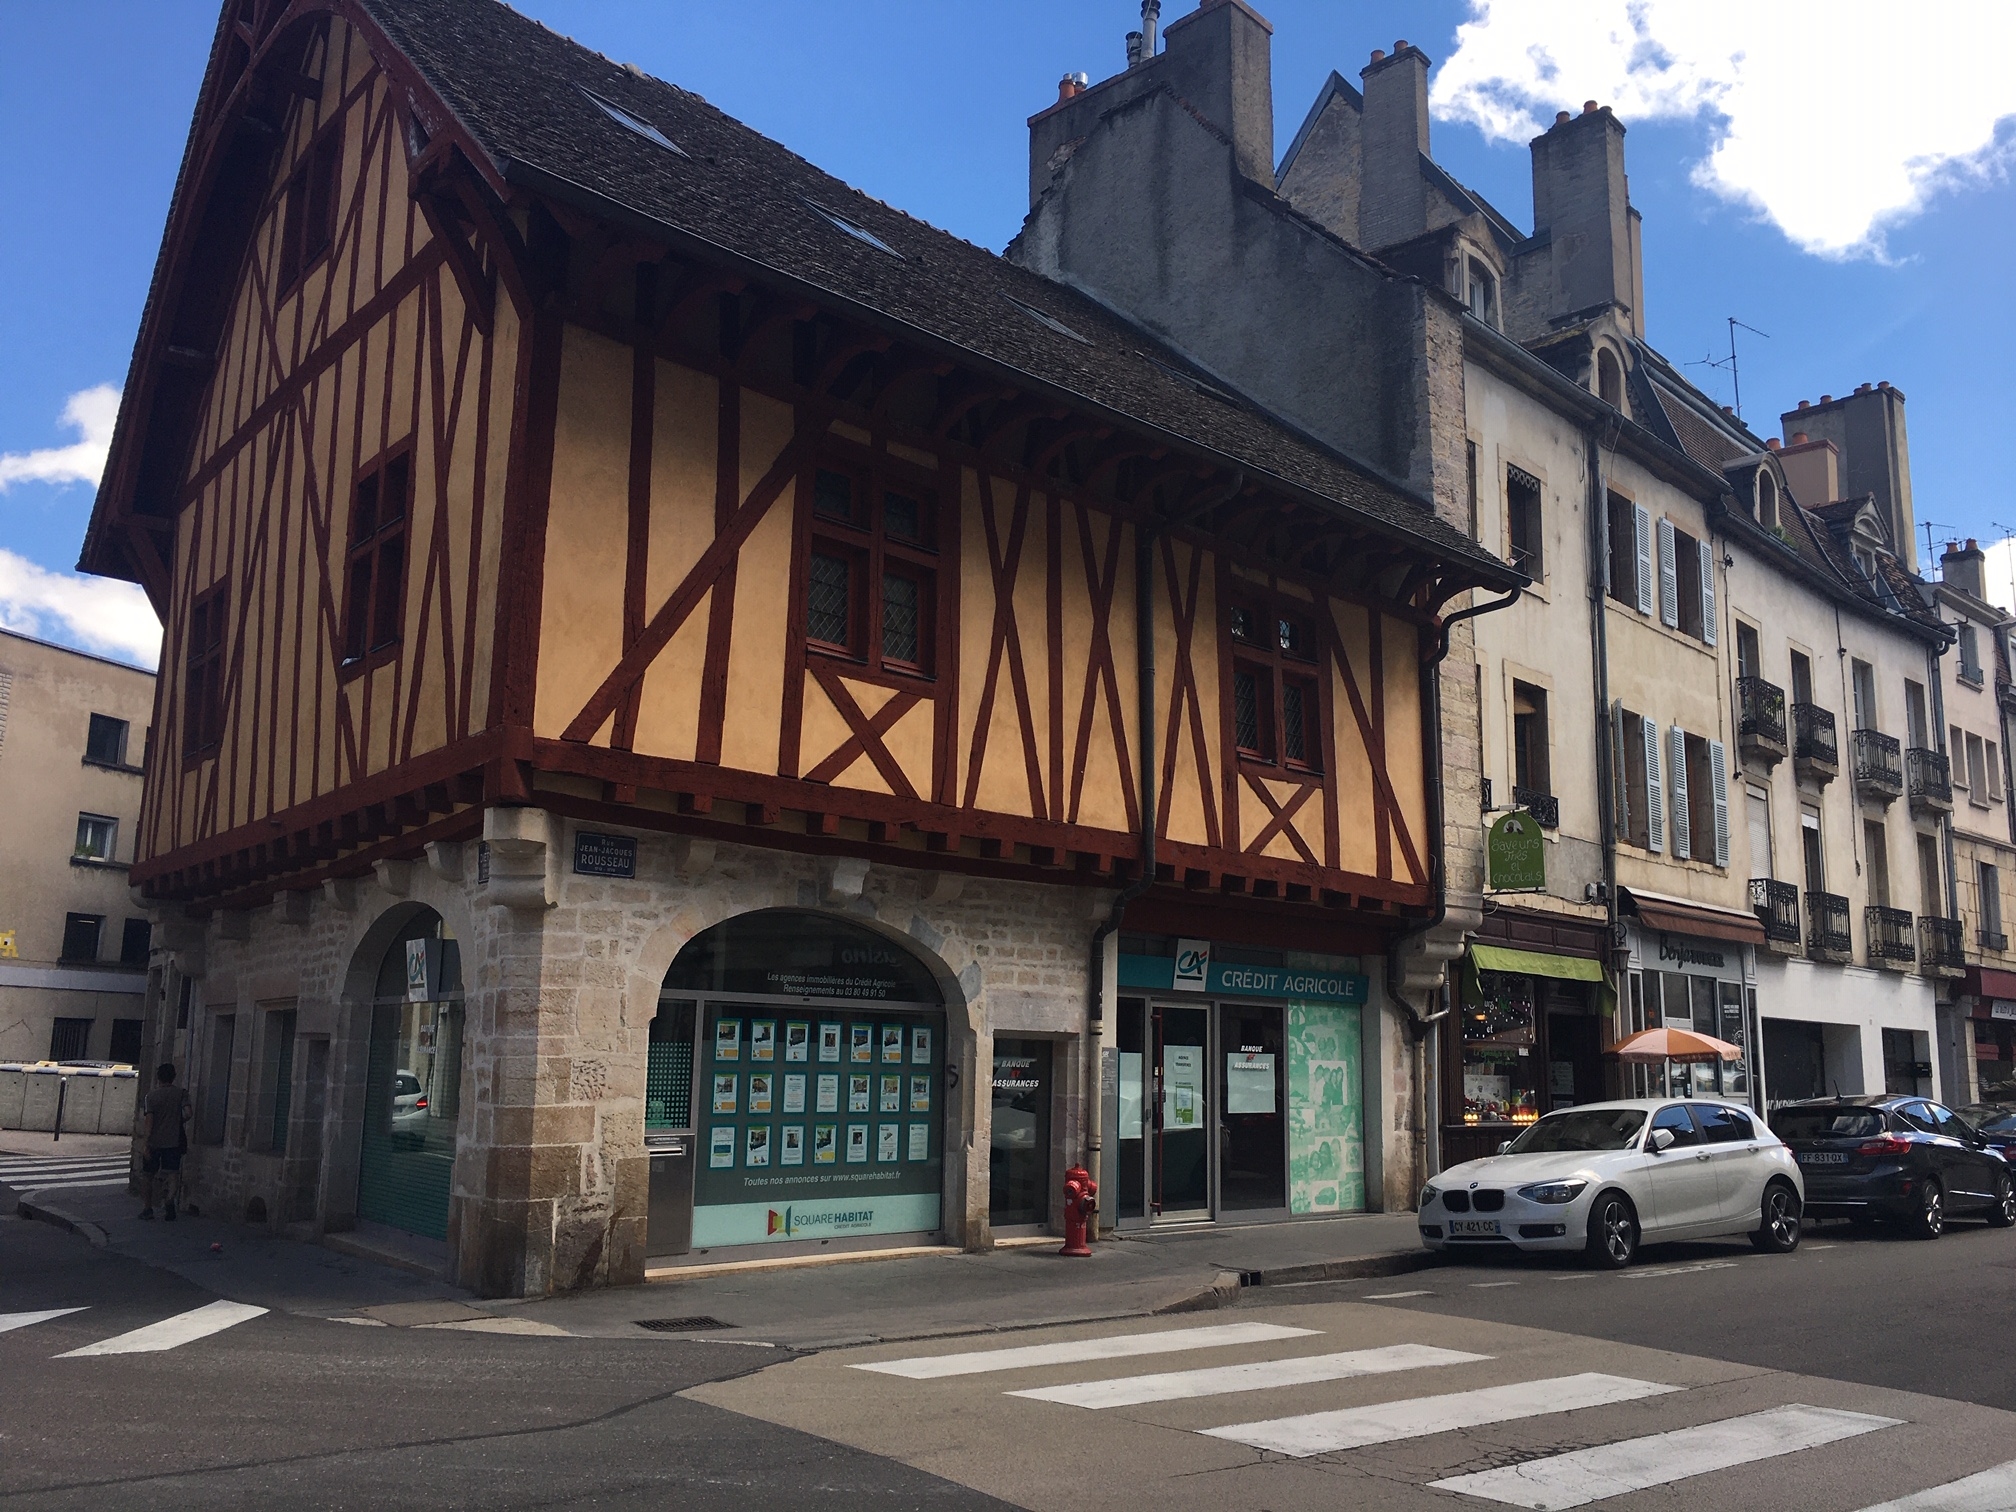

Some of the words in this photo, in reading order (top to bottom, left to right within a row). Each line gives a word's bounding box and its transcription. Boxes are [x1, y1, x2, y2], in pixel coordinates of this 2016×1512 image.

[602, 839, 614, 847] Rue
[1492, 838, 1540, 851] Saveurs
[580, 845, 632, 857] JEAN-JACQUES
[581, 854, 630, 869] ROUSSEAU
[767, 972, 779, 981] Les
[780, 974, 806, 984] agences
[845, 977, 854, 986] du
[854, 977, 872, 987] Crédit
[872, 978, 896, 989] Agricole
[1222, 969, 1278, 990] CRÉDIT
[1283, 975, 1354, 996] AGRICOLE
[783, 983, 835, 995] Renseignements
[1001, 1060, 1030, 1068] BANQUE
[992, 1079, 1040, 1088] ASSURANCES
[744, 1177, 768, 1187] Toutes
[769, 1177, 783, 1185] nos
[784, 1175, 819, 1184] annonces
[820, 1174, 831, 1183] sur
[832, 1171, 901, 1182] www.squarehabitat.fr
